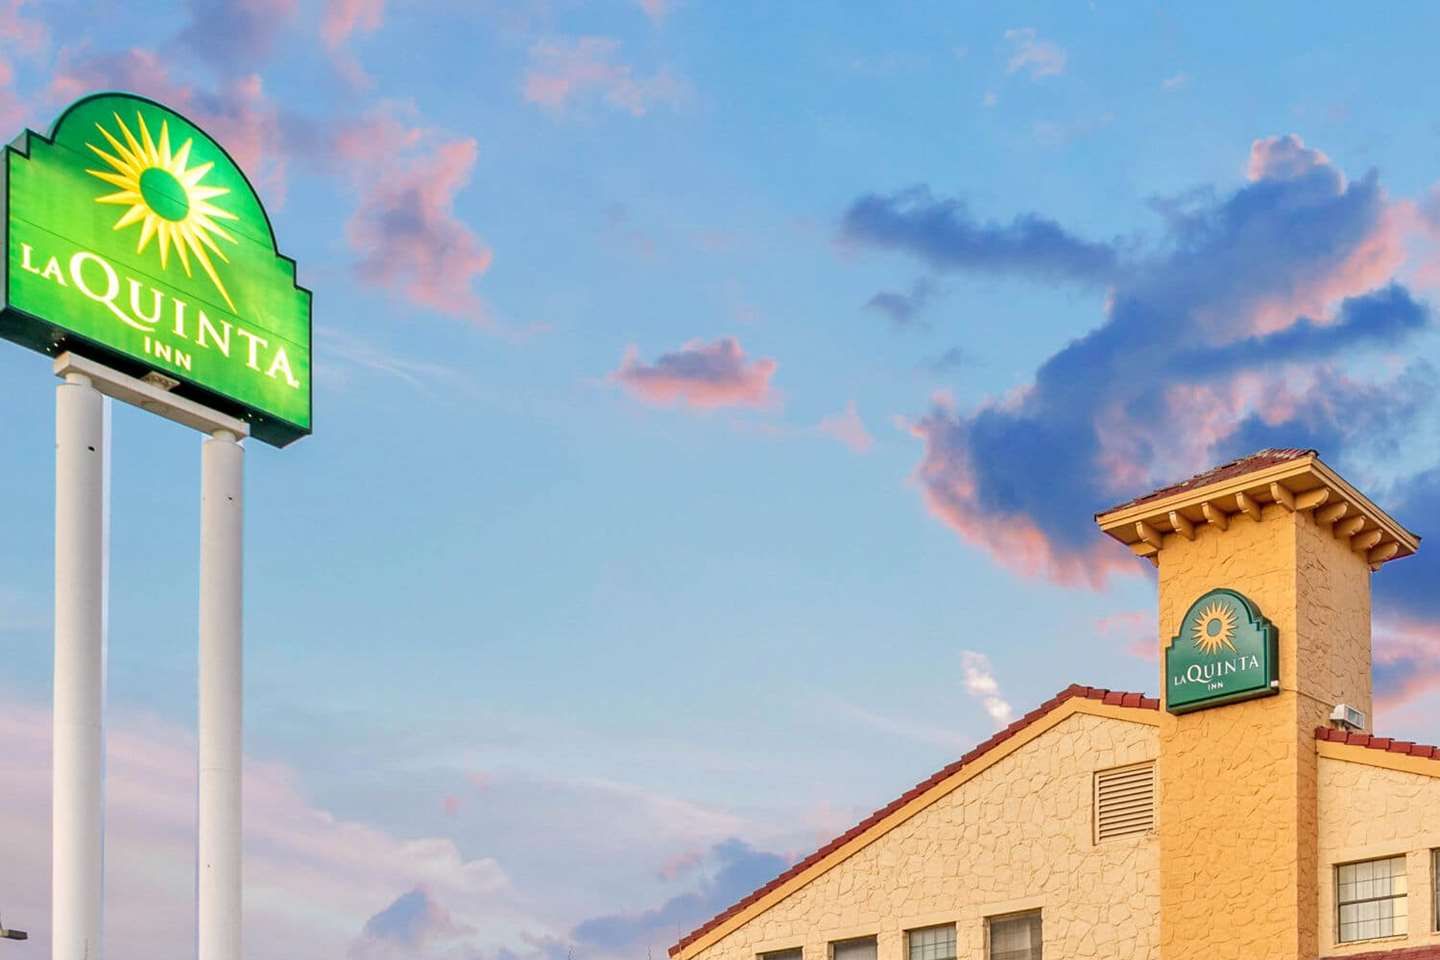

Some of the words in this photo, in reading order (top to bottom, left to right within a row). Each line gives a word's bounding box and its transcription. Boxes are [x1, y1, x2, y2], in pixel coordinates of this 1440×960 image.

[19, 243, 68, 288] LA
[69, 251, 301, 389] QUINTA
[144, 335, 192, 371] INN
[1174, 675, 1187, 686] LA
[1187, 655, 1259, 684] QUINTA
[1207, 681, 1224, 691] INN
